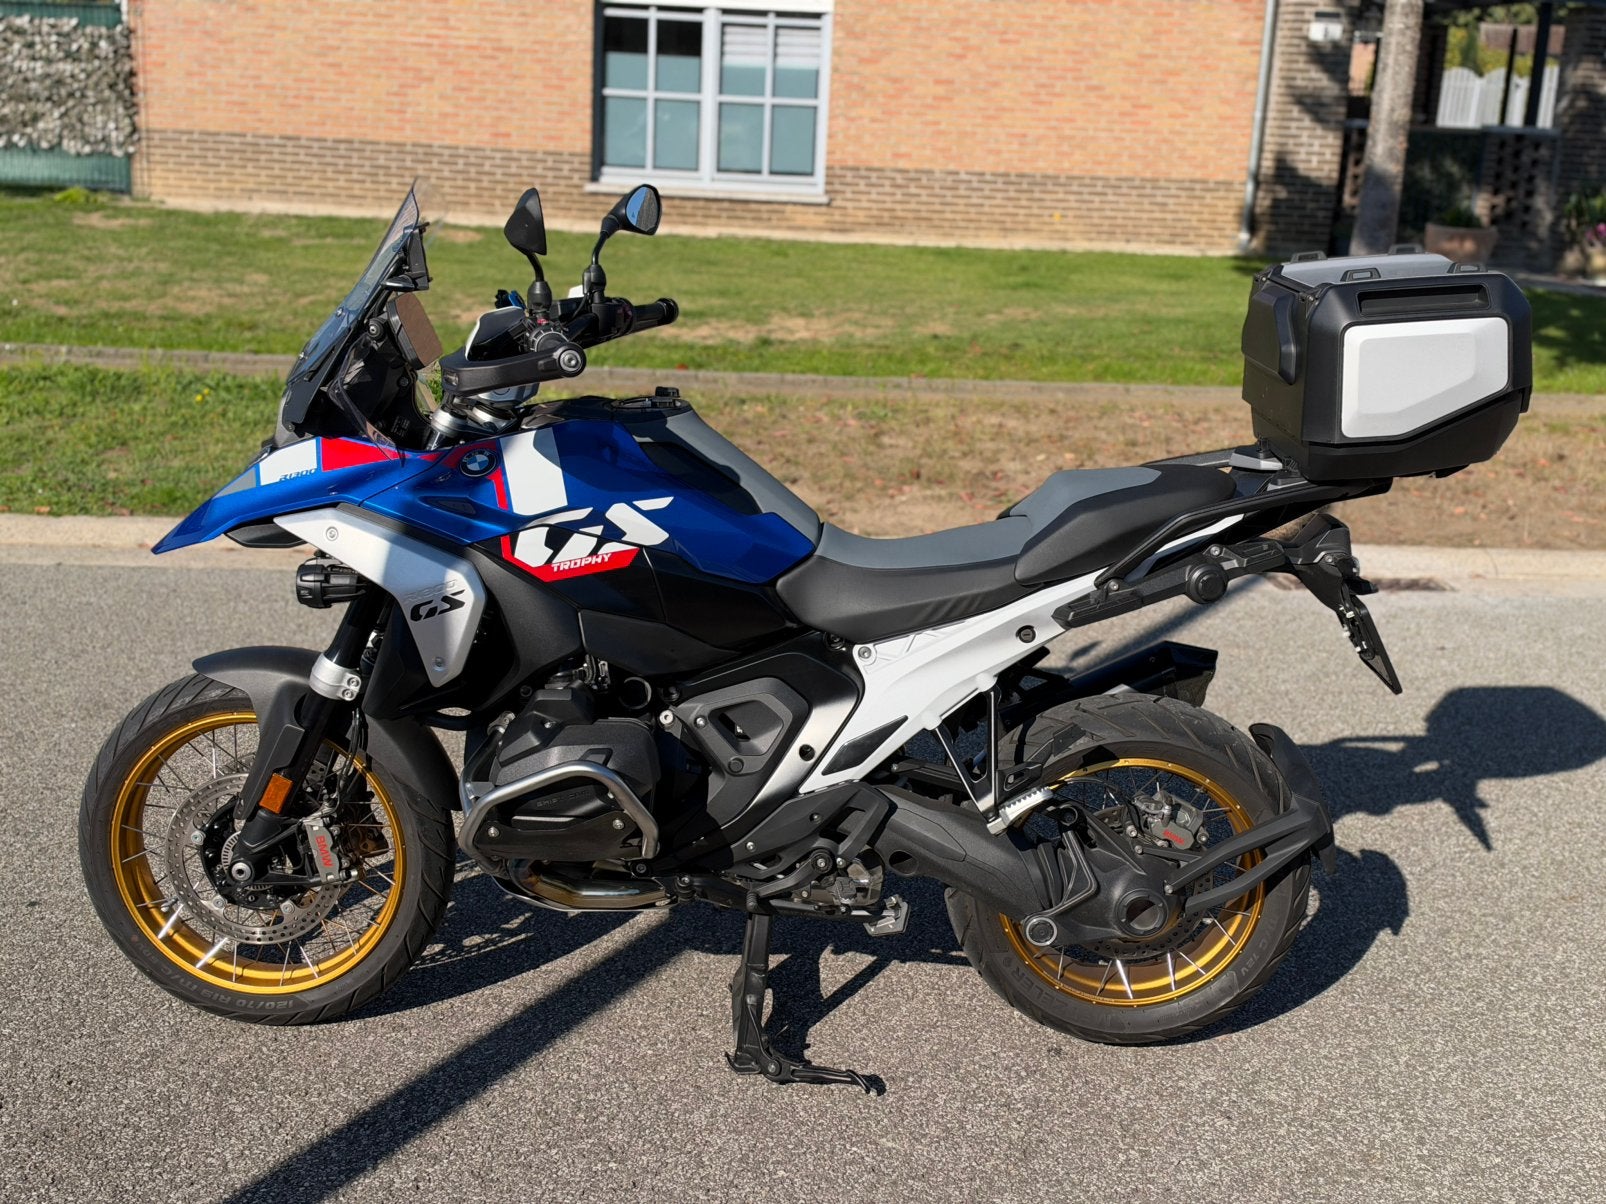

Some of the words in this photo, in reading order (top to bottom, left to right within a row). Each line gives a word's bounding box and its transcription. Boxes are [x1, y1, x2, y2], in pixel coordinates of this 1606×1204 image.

[514, 496, 674, 568] GS
[551, 553, 612, 573] TROPHY
[410, 589, 466, 622] GS
[316, 835, 334, 867] BMW
[200, 988, 232, 1004] R19
[235, 998, 294, 1010] 120/70
